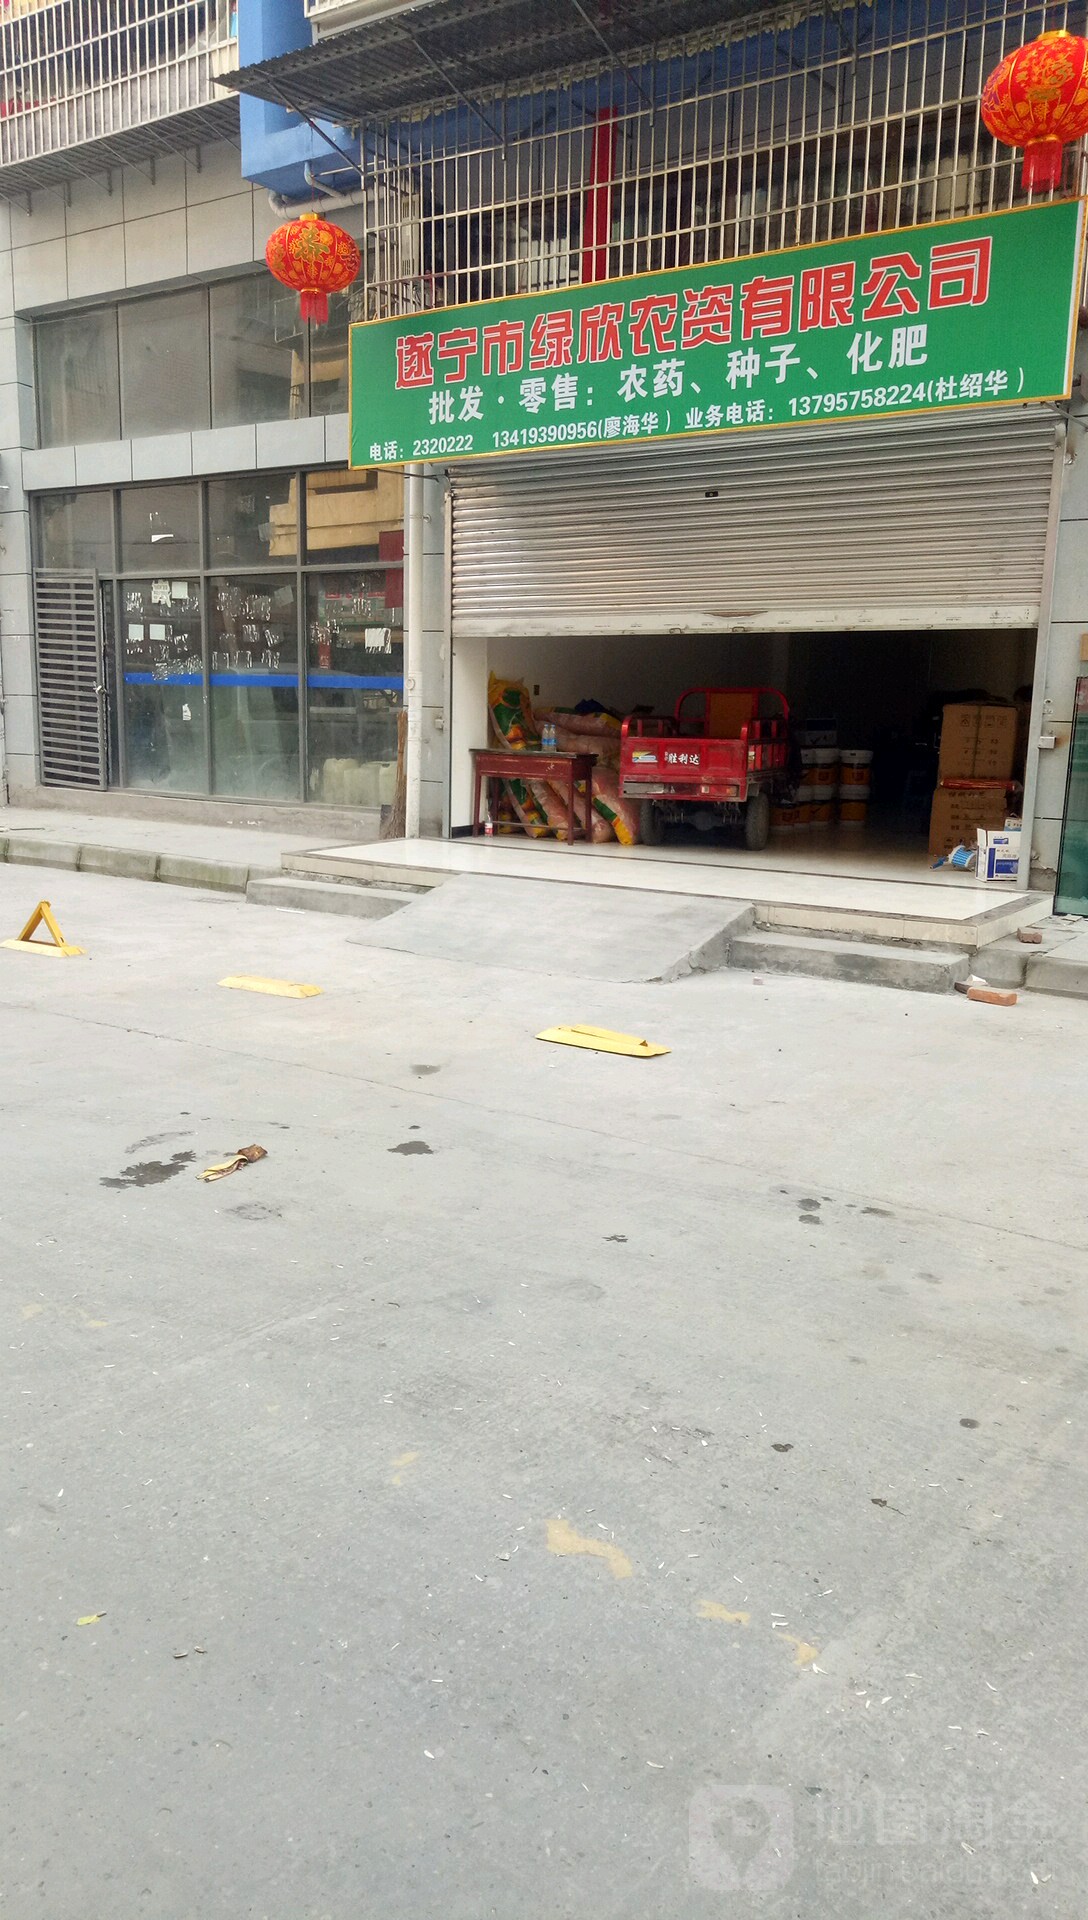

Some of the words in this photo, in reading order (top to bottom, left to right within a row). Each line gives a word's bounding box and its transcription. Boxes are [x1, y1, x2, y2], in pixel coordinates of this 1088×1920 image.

[394, 236, 993, 390] 遂宁市绿欣农资有限公司
[667, 752, 699, 765] 胜利达
